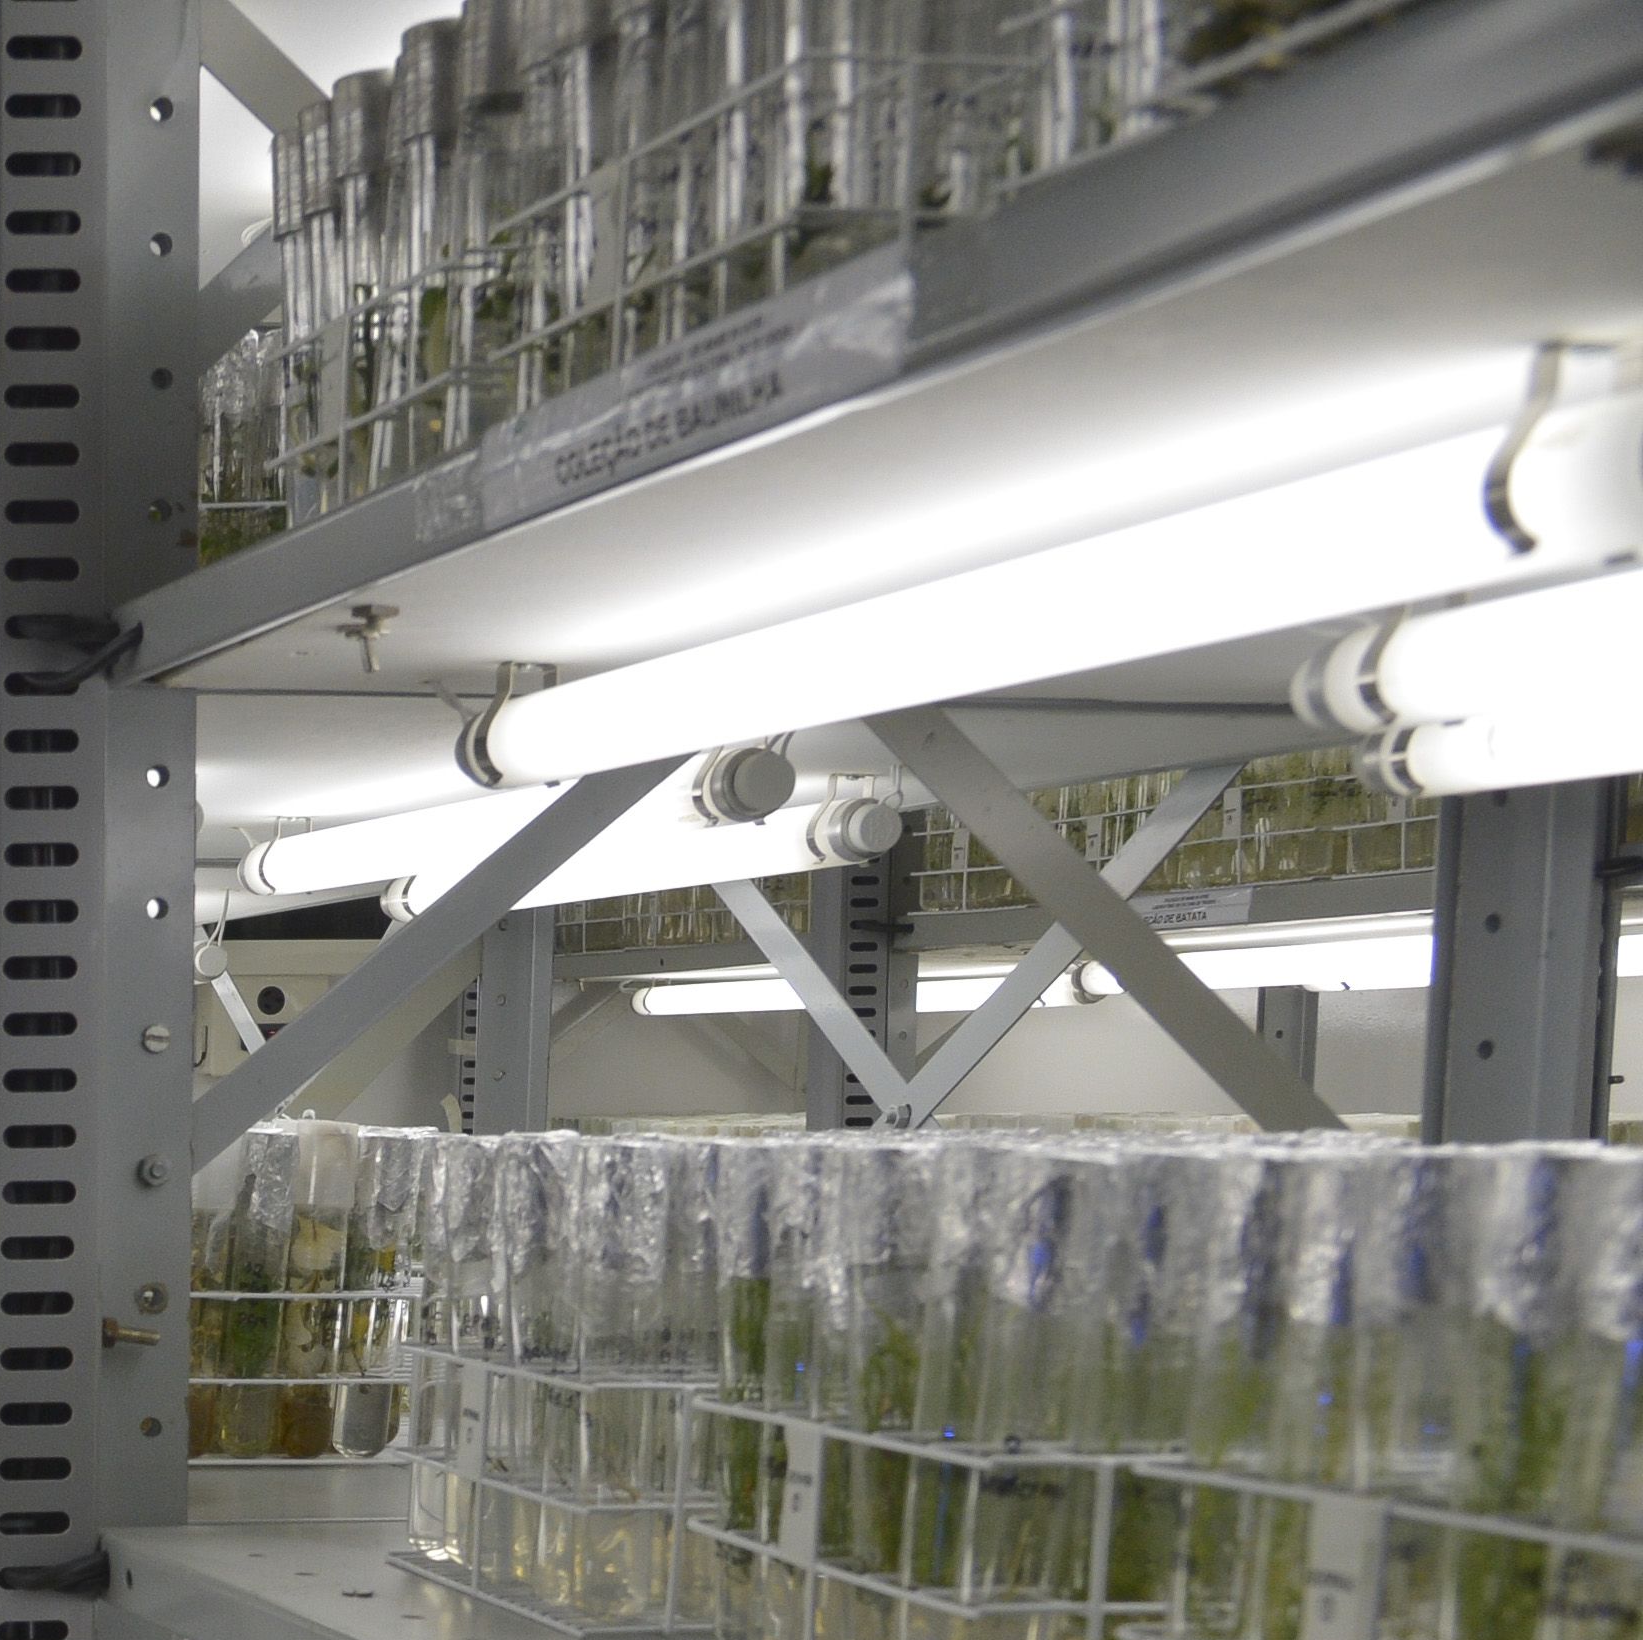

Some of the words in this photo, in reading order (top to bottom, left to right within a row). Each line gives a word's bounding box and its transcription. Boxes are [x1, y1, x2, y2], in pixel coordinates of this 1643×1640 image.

[555, 426, 640, 485] COLEÇÃO
[644, 418, 670, 450] DE
[1175, 911, 1208, 923] BATATA
